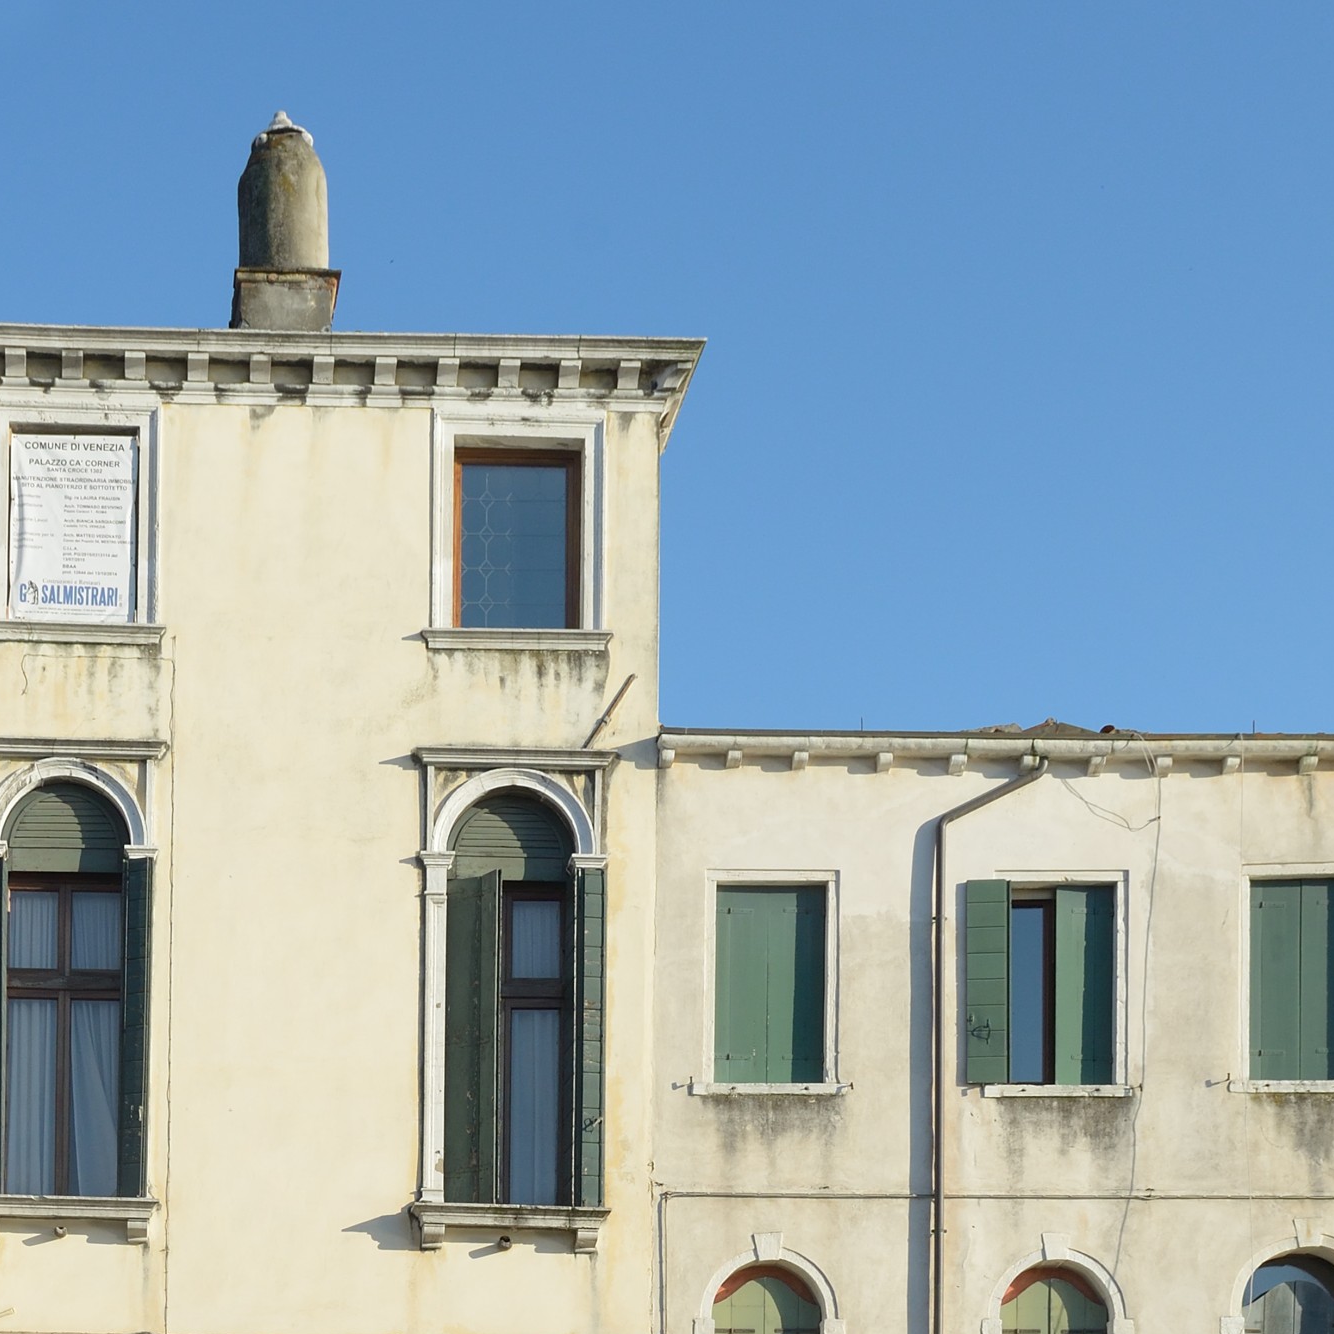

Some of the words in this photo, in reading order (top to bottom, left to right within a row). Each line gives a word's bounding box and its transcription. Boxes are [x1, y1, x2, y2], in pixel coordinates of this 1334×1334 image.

[24, 442, 68, 450] COMUNE
[70, 442, 80, 451] DI
[83, 443, 125, 452] VENEZIA
[29, 458, 67, 466] PALAZZO
[85, 460, 120, 468] CORNER
[41, 584, 118, 607] SALMISTRARI
